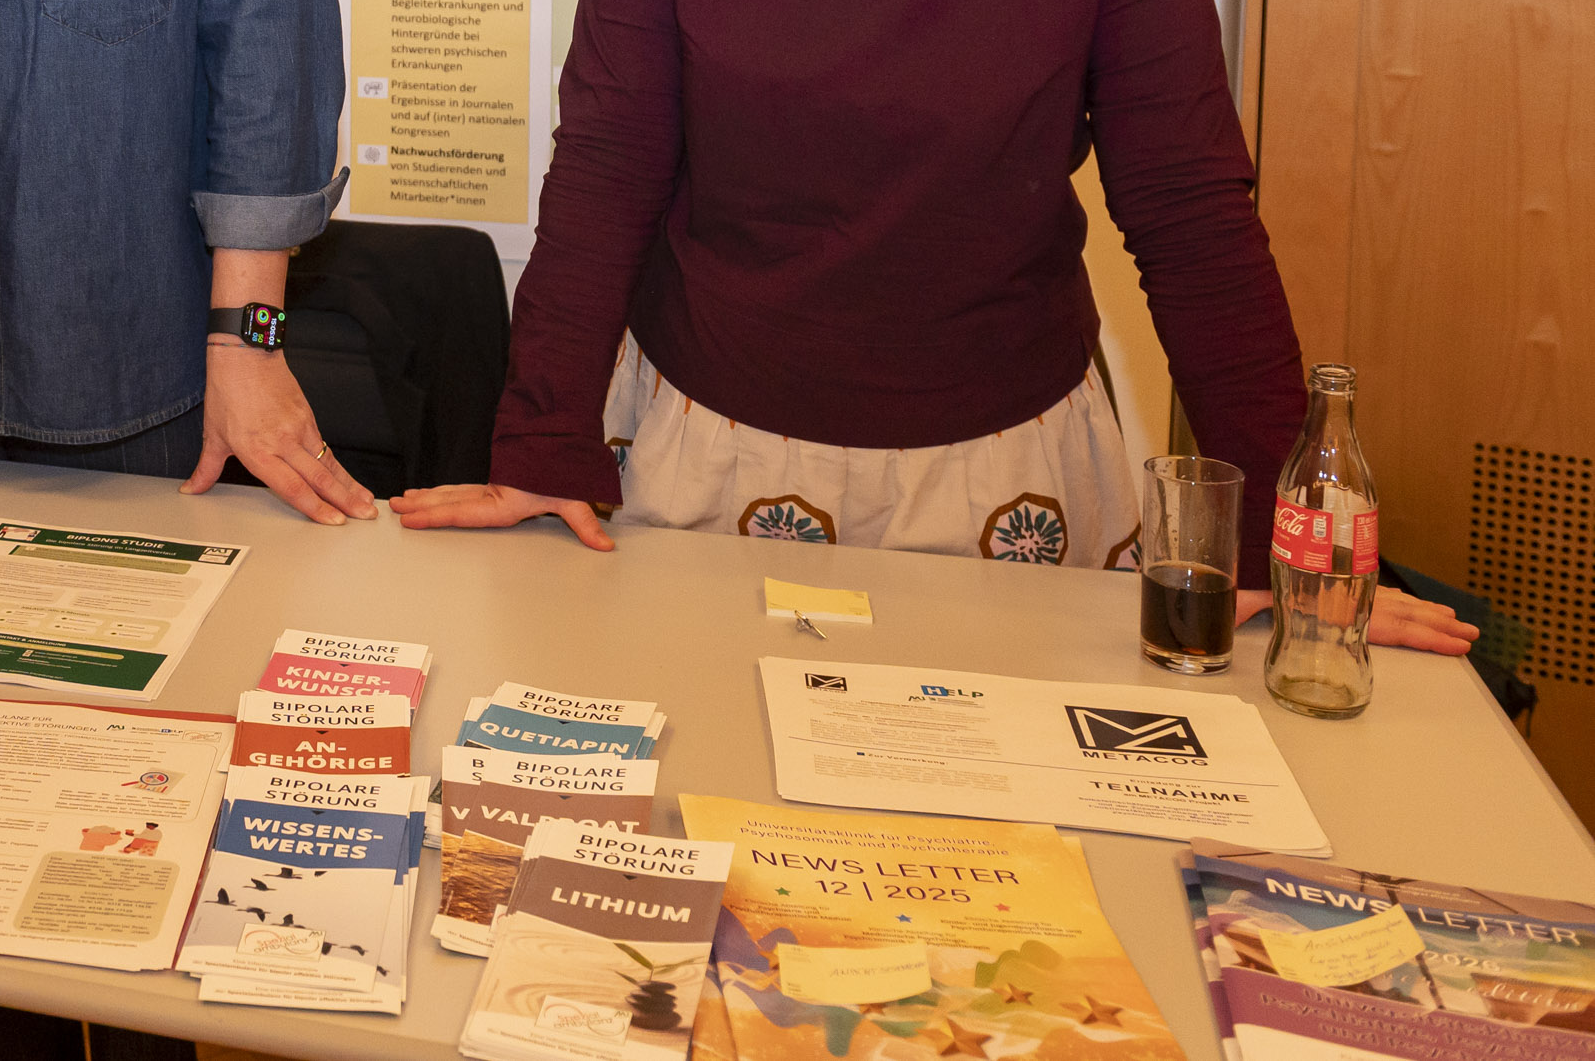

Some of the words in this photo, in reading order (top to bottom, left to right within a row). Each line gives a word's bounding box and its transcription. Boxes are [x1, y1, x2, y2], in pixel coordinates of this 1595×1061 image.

[503, 3, 523, 12] und
[392, 14, 481, 25] neurobiologische
[392, 29, 460, 41] Hintergründe
[464, 31, 480, 41] bei
[392, 45, 440, 55] schweren
[444, 48, 507, 58] psychischen
[392, 60, 462, 71] Erkrankungen
[392, 80, 456, 91] Präsentation
[460, 83, 477, 92] der
[392, 96, 446, 107] Ergebnisse
[450, 99, 458, 107] in
[462, 99, 513, 110] Journalen
[391, 112, 410, 121] und
[414, 113, 430, 121] auf
[433, 113, 465, 125] (inter)
[469, 116, 525, 126] nationalen
[391, 126, 450, 138] Kongressen
[391, 146, 504, 162] Nachwuchsförderung
[391, 163, 409, 171] von
[413, 163, 483, 175] Studierenden
[486, 167, 506, 176] und
[390, 178, 488, 190] wissenschaftlichen
[67, 535, 119, 543] BIPLONG
[121, 540, 165, 548] STUDIE
[304, 637, 400, 654] BIPOLARE
[300, 646, 397, 663] STÖRUNG
[286, 666, 390, 685] KINDER-
[277, 677, 390, 696] WUNSCH
[273, 701, 375, 713] BIPOLARE
[523, 691, 625, 712] BIPOLARE
[271, 712, 375, 725] STÖRUNG
[518, 701, 620, 722] STÖRUNG
[34, 722, 98, 733] STÖRUNGEN
[480, 722, 630, 754] QUETIAPIN
[295, 741, 347, 753] AN-
[249, 752, 393, 770] GEHÖRIGE
[1083, 751, 1208, 766] METACOG
[517, 761, 627, 777] BIPOLARE
[270, 777, 381, 795] BIPOLARE
[512, 775, 624, 791] STÖRUNG
[265, 789, 377, 808] STÖRUNG
[1090, 781, 1250, 803] TEILNAHME
[244, 817, 384, 841] WISSENS-
[747, 820, 876, 840] Universitätsklinik
[249, 835, 367, 859] WERTES
[580, 834, 701, 861] BIPOLARE
[740, 827, 853, 846] Psychosomatik
[859, 840, 886, 849] und
[891, 841, 1009, 857] Psychotherapie
[574, 848, 695, 876] STÖRUNG
[751, 850, 865, 875] NEWS
[876, 861, 1020, 885] LETTER
[815, 880, 852, 896] 12
[884, 885, 971, 903] 2025
[551, 887, 691, 924] LITHIUM
[1266, 879, 1395, 913] NEWS
[1418, 907, 1580, 946] LETTER
